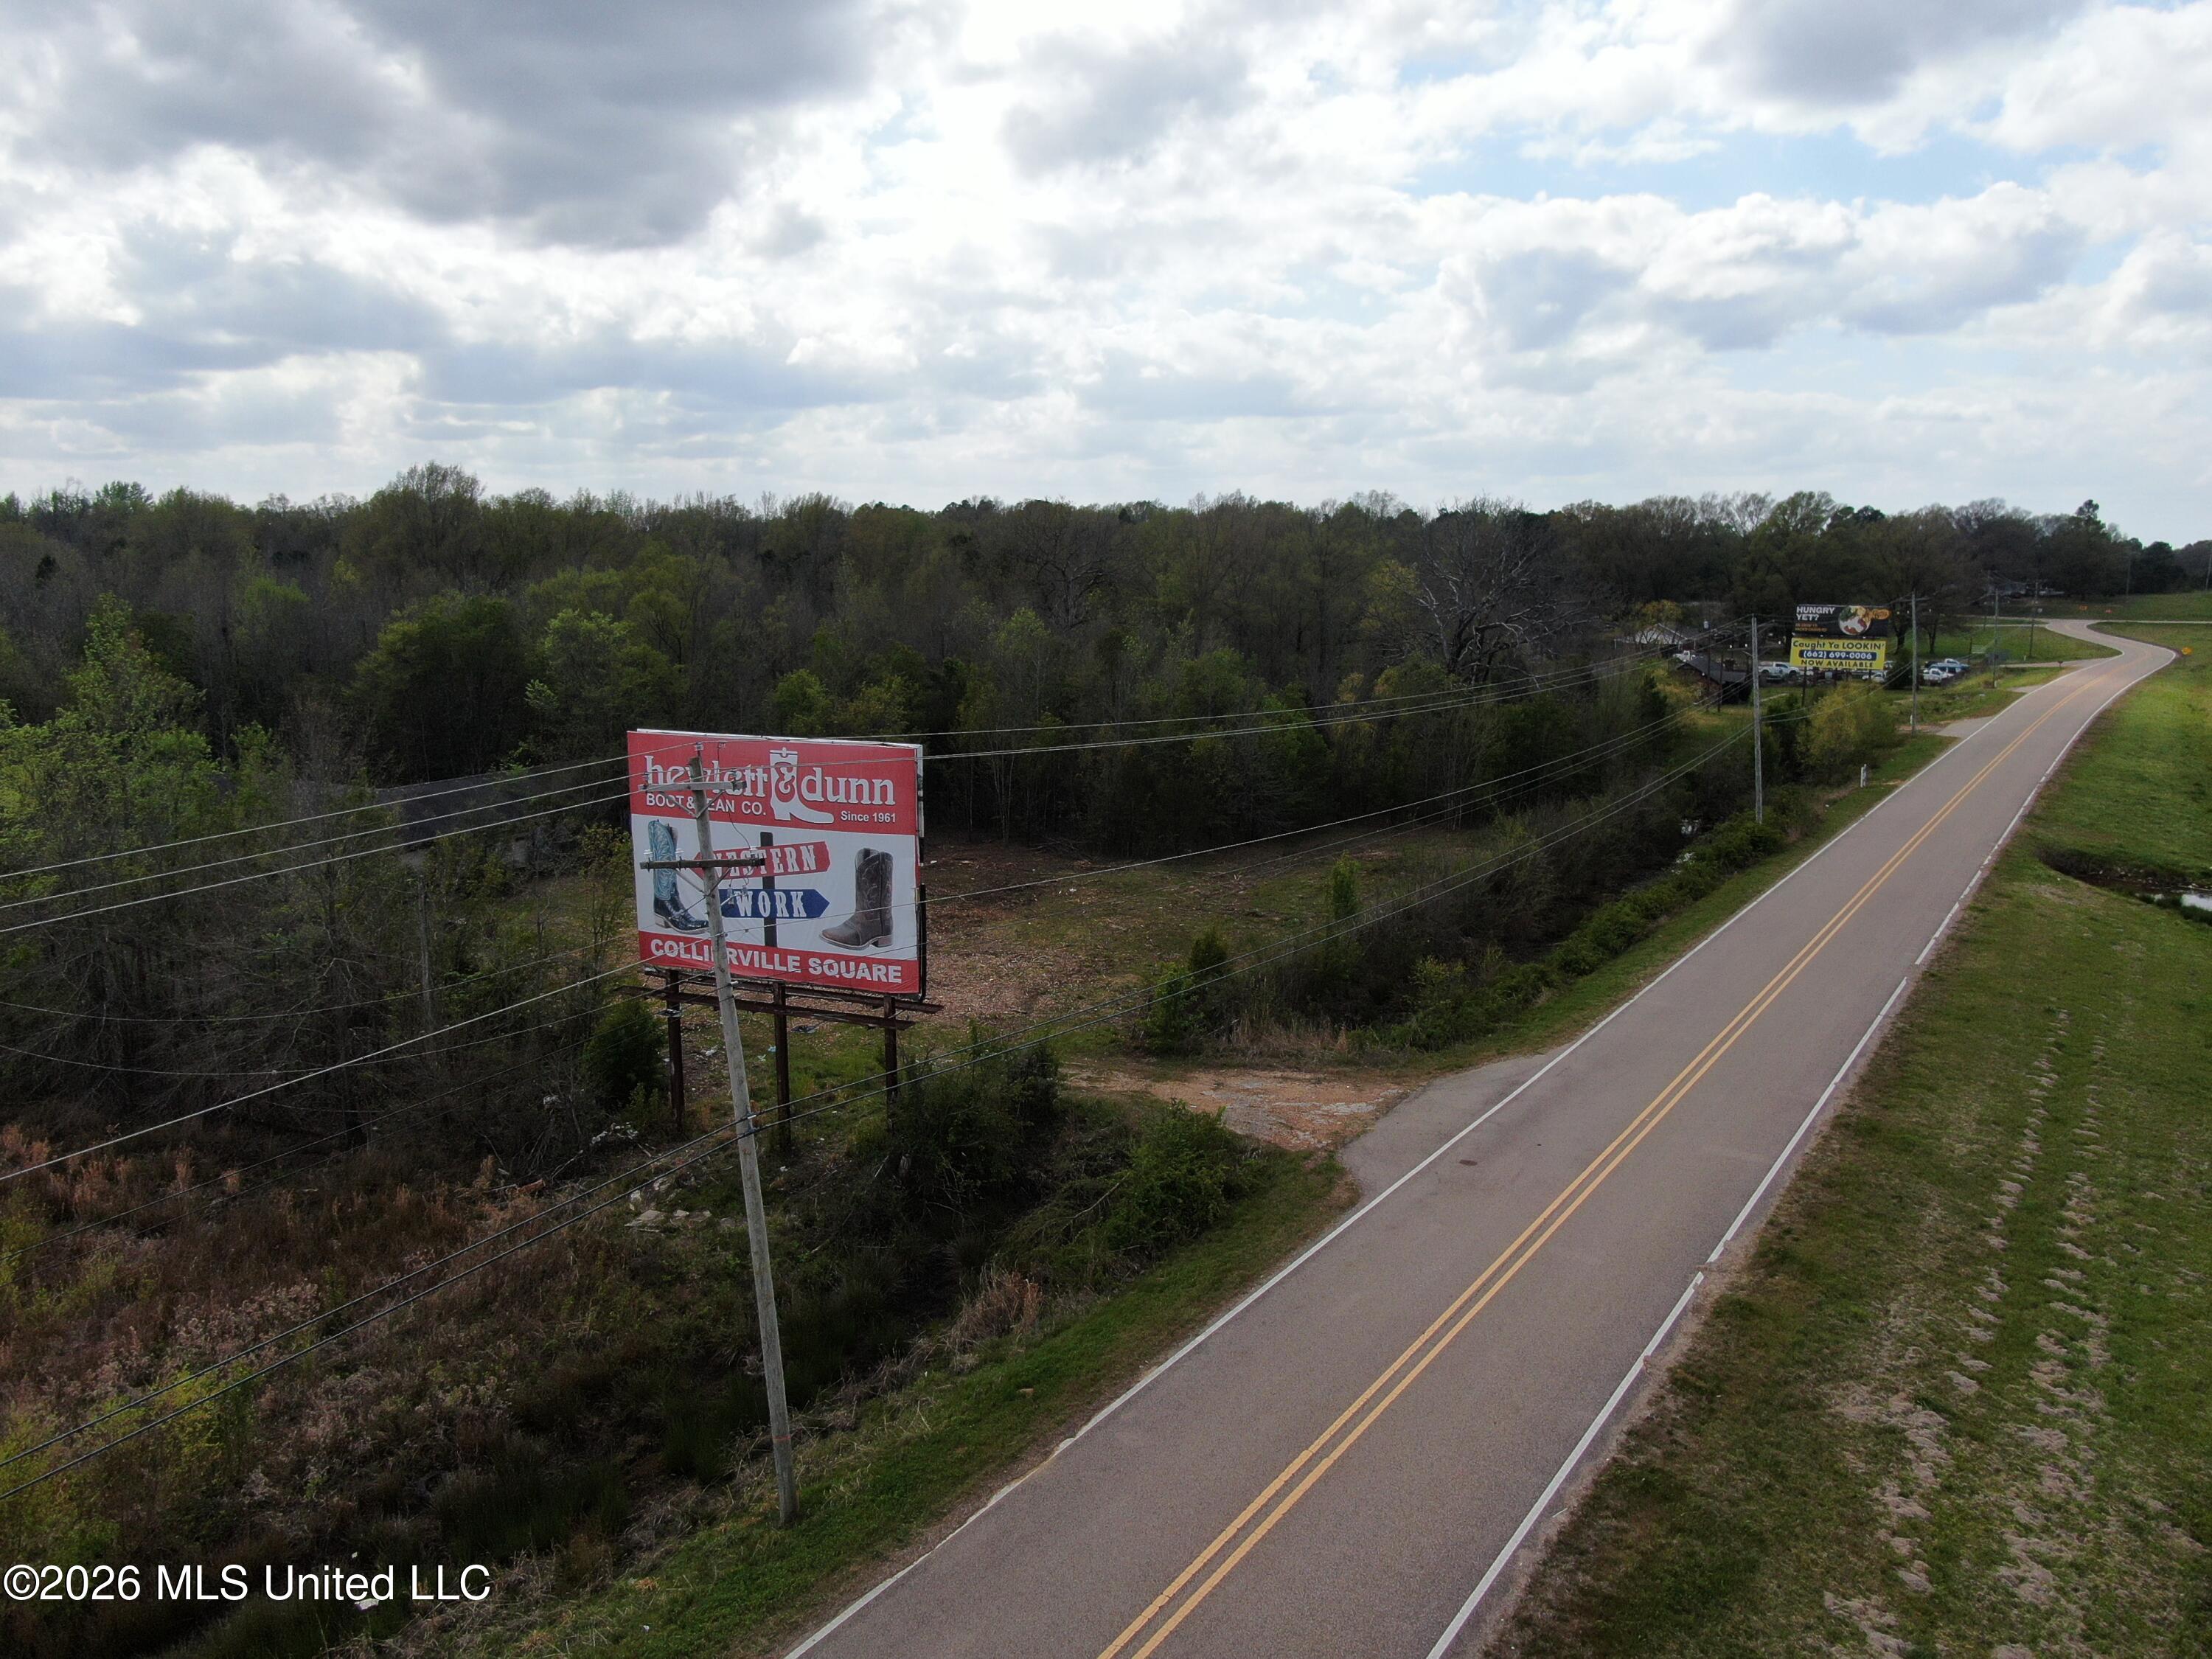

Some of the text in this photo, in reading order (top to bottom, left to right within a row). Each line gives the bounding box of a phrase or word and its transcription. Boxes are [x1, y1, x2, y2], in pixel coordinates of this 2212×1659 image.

[1792, 640, 1825, 650] Caught
[1842, 641, 1885, 650] LOOKIN'
[1803, 650, 1826, 658] (662)
[801, 767, 896, 805] dunn
[699, 798, 734, 813] EAN
[741, 801, 766, 815] CO.
[841, 810, 896, 823] Since 1961
[734, 891, 807, 917] WORK
[650, 939, 902, 983] COLLIRVILLE SQUARE
